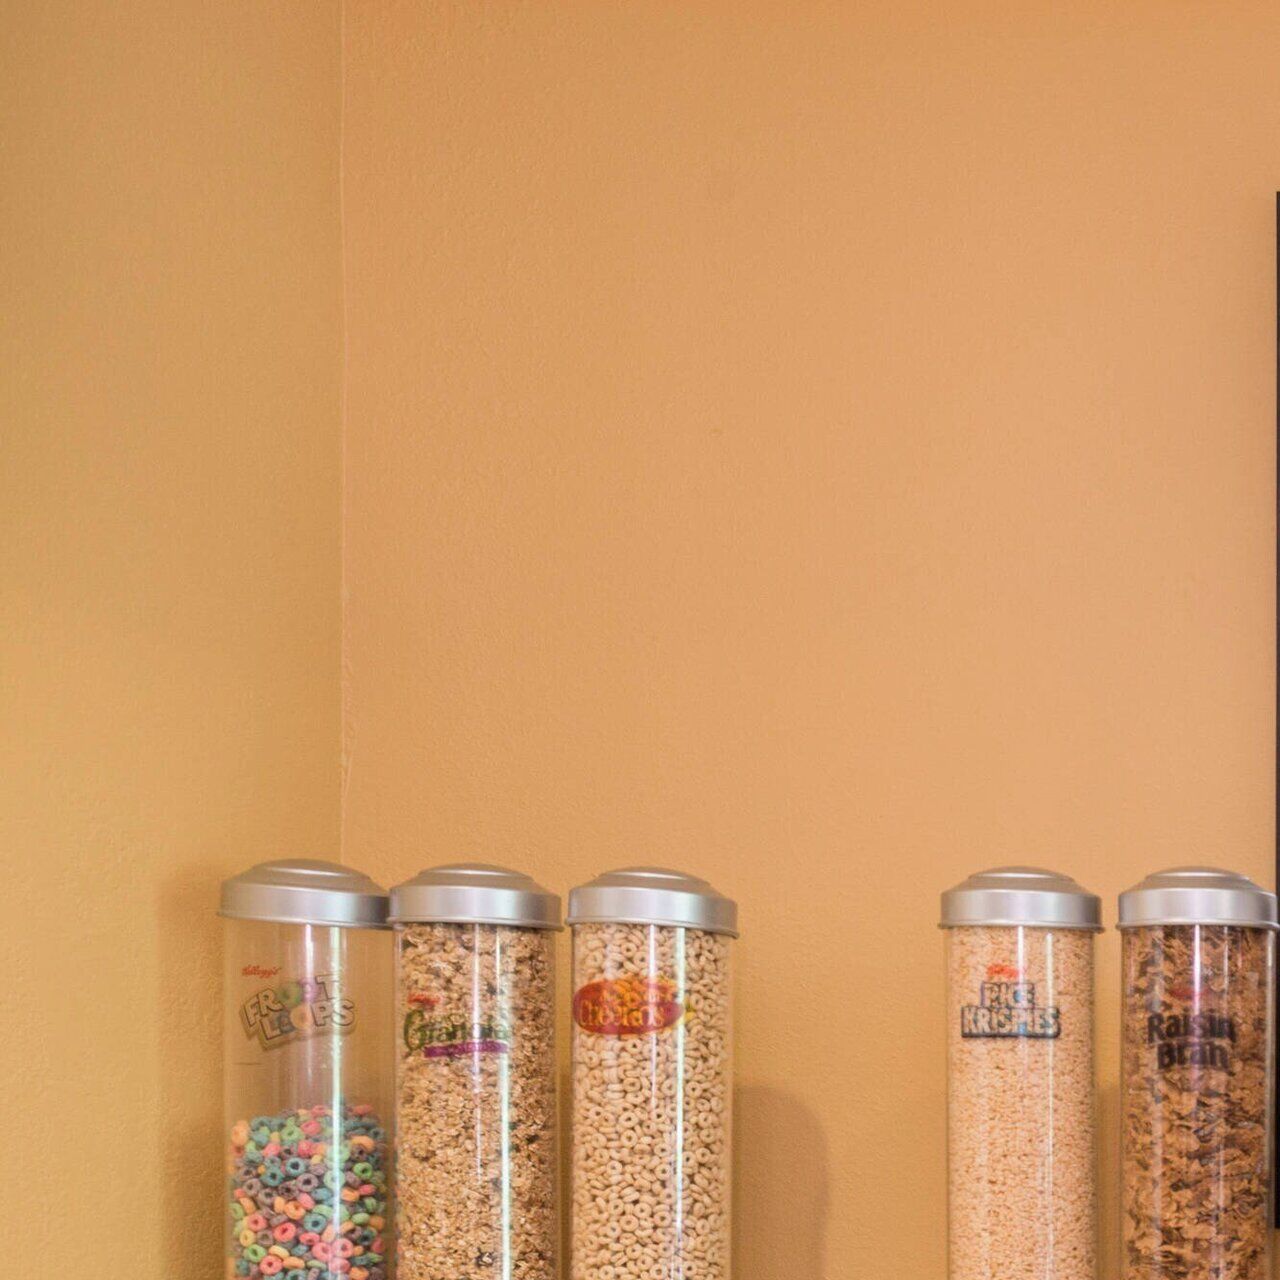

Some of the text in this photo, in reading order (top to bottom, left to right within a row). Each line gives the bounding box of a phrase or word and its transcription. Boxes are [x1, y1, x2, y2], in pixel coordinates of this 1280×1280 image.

[980, 981, 1035, 1008] RICE
[961, 1005, 1061, 1038] KRISPIES
[1147, 1006, 1237, 1045] Raisin
[1157, 1040, 1235, 1076] Bran
